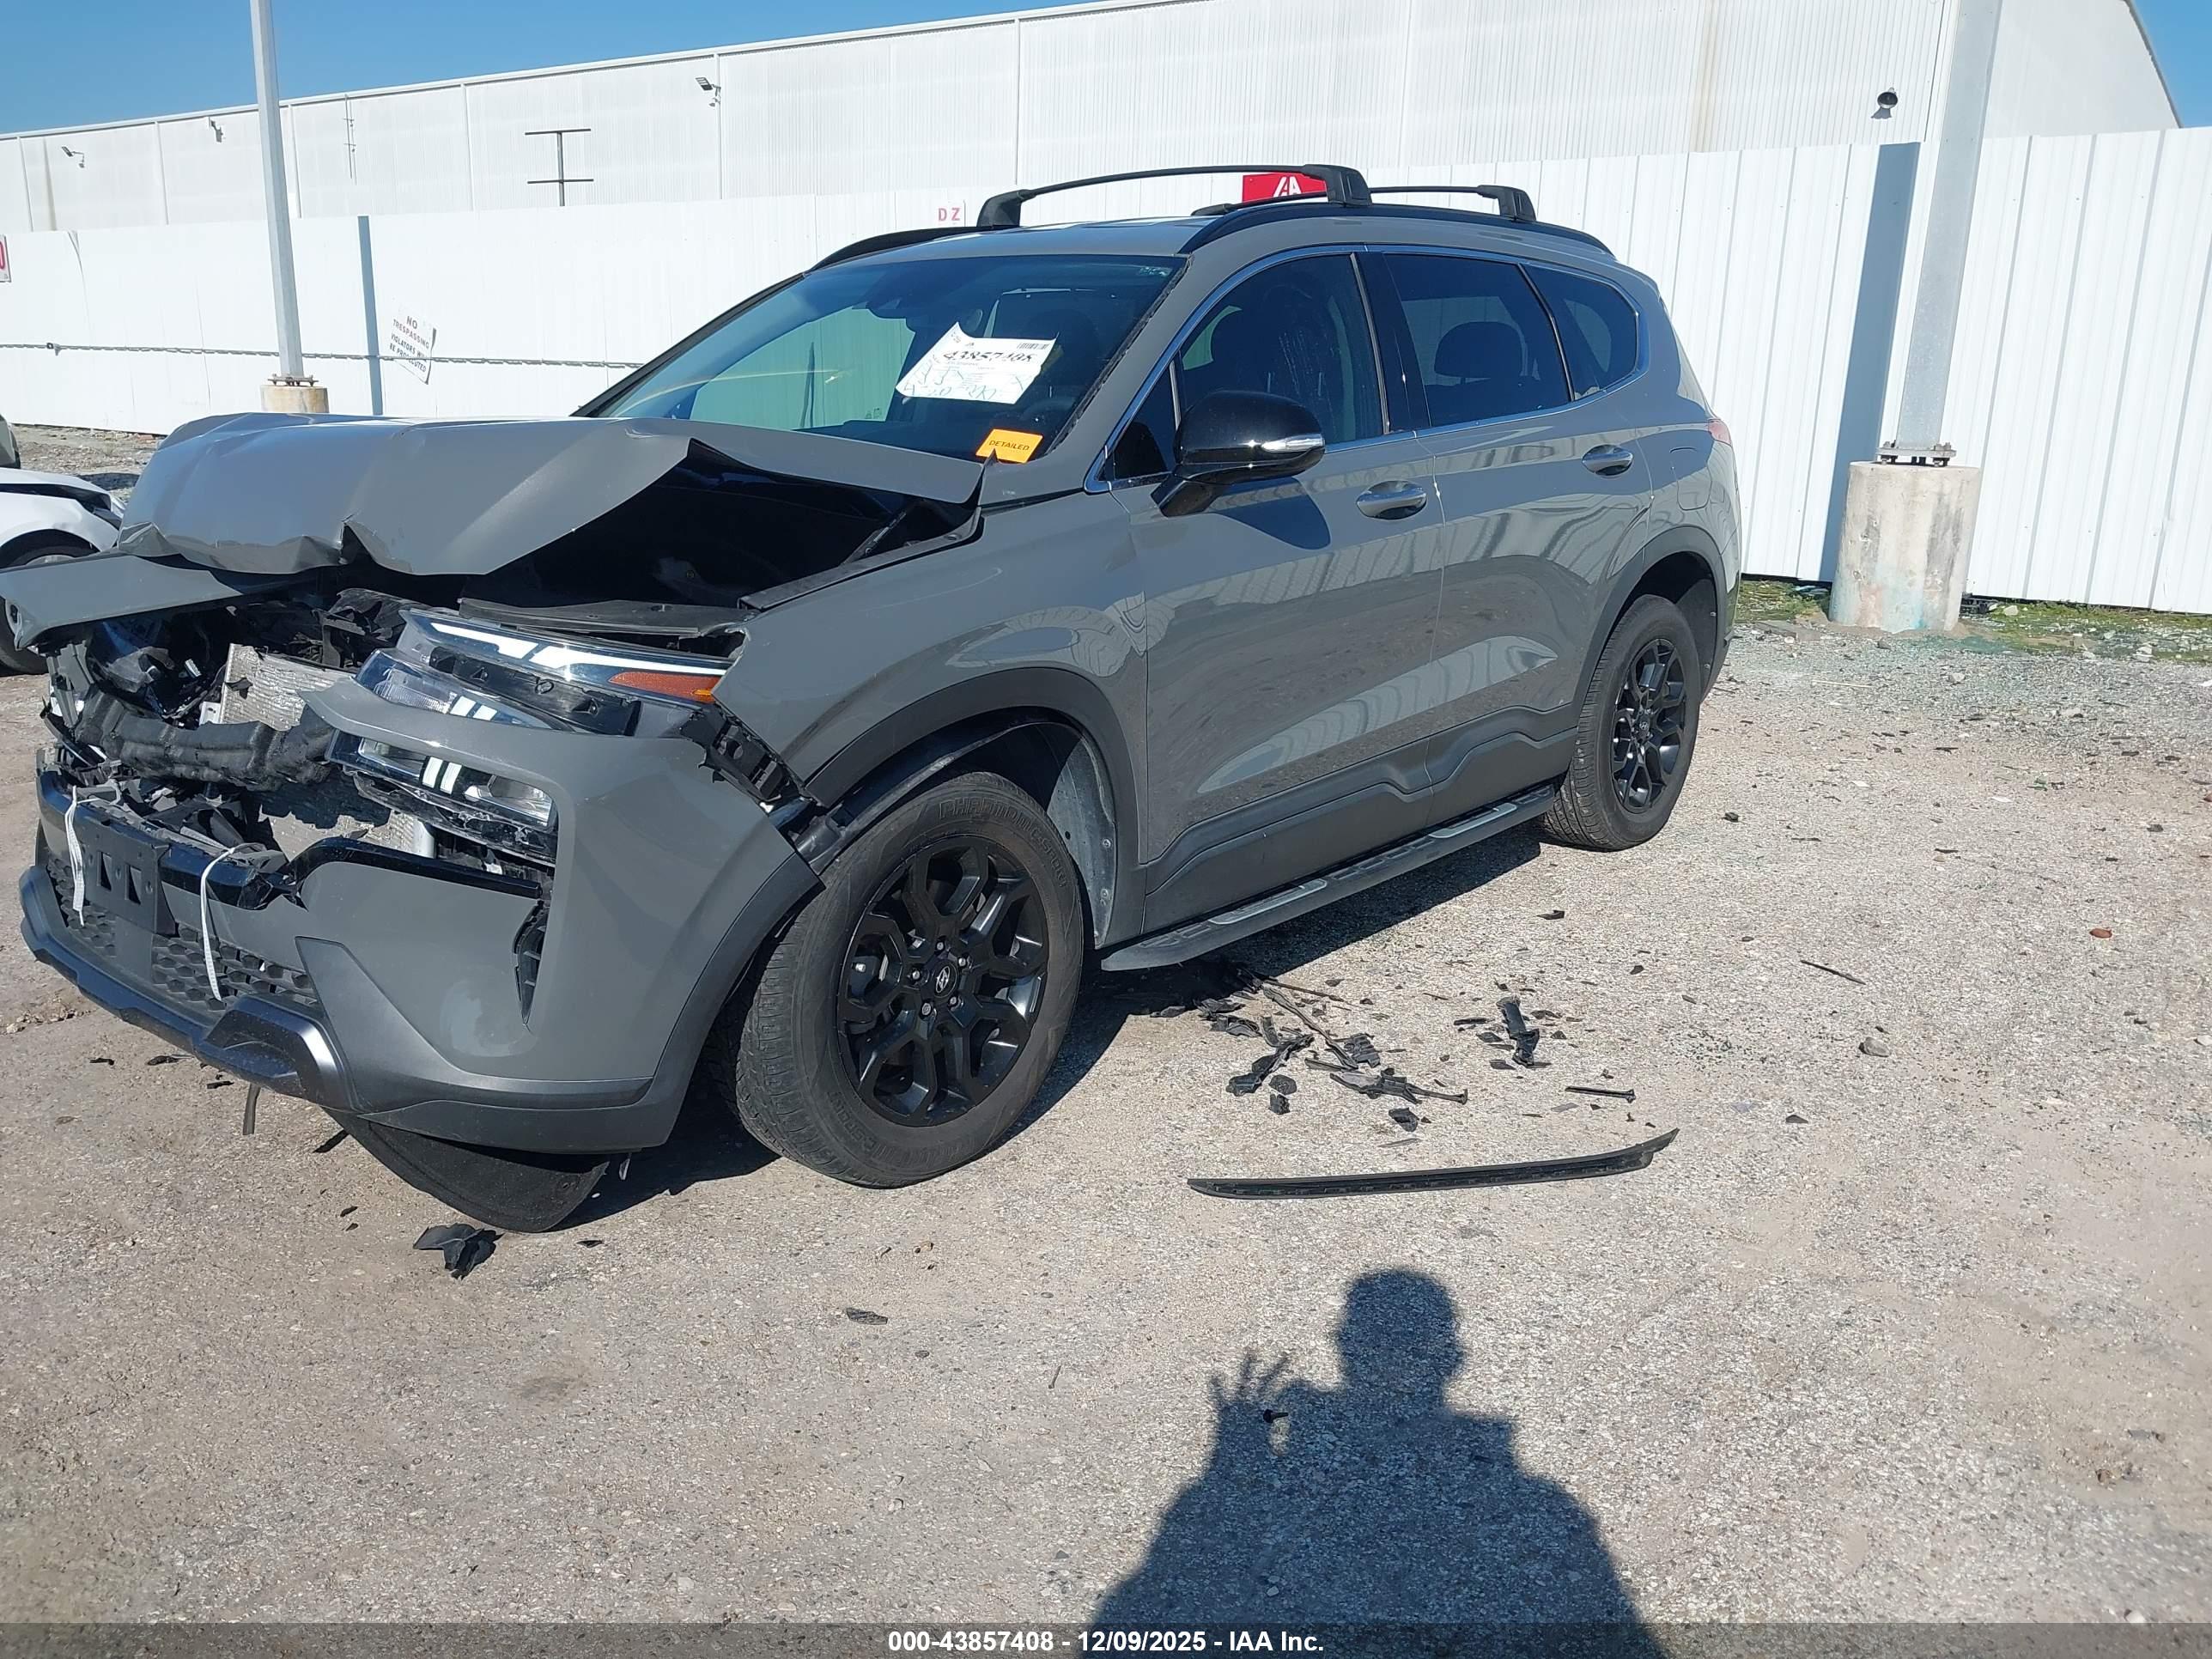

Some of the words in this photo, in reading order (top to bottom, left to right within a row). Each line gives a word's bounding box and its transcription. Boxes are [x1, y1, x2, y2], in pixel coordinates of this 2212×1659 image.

[406, 315, 418, 330] NO
[393, 319, 429, 349] TRESPASSING
[389, 343, 396, 352] BE
[391, 332, 416, 355] VIOLATORS
[988, 440, 1030, 451] DETAILED
